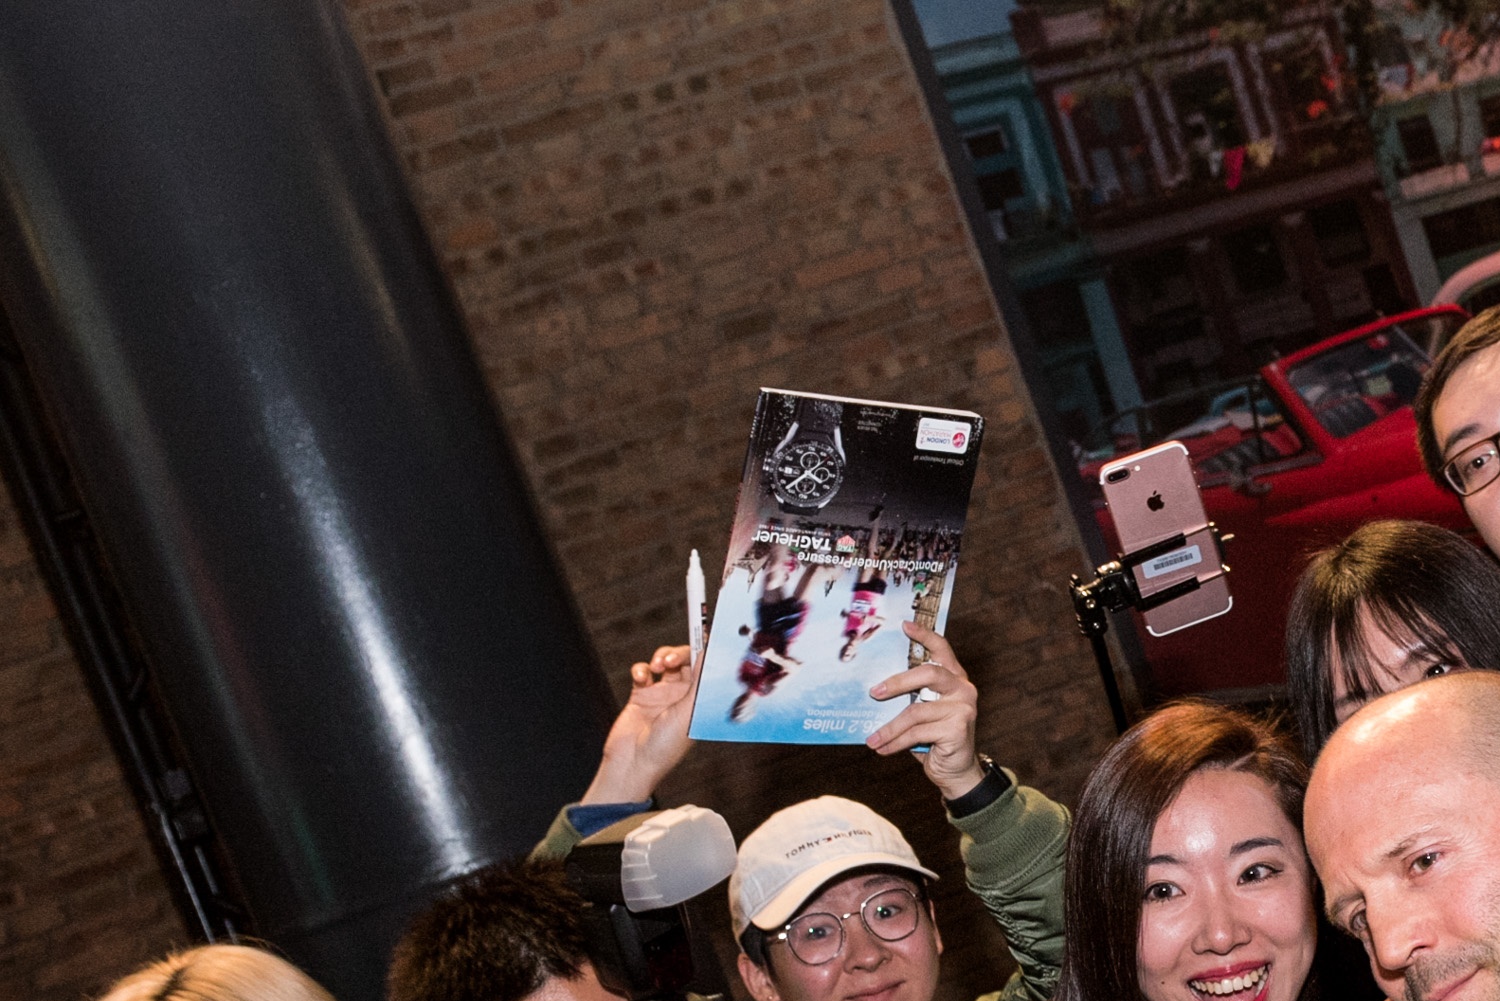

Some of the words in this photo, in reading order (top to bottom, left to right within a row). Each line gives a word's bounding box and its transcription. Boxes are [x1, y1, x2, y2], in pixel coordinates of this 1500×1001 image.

[797, 551, 944, 572] #DontCrackUnderPressure
[803, 719, 845, 733] miles
[785, 840, 820, 858] TOMMY
